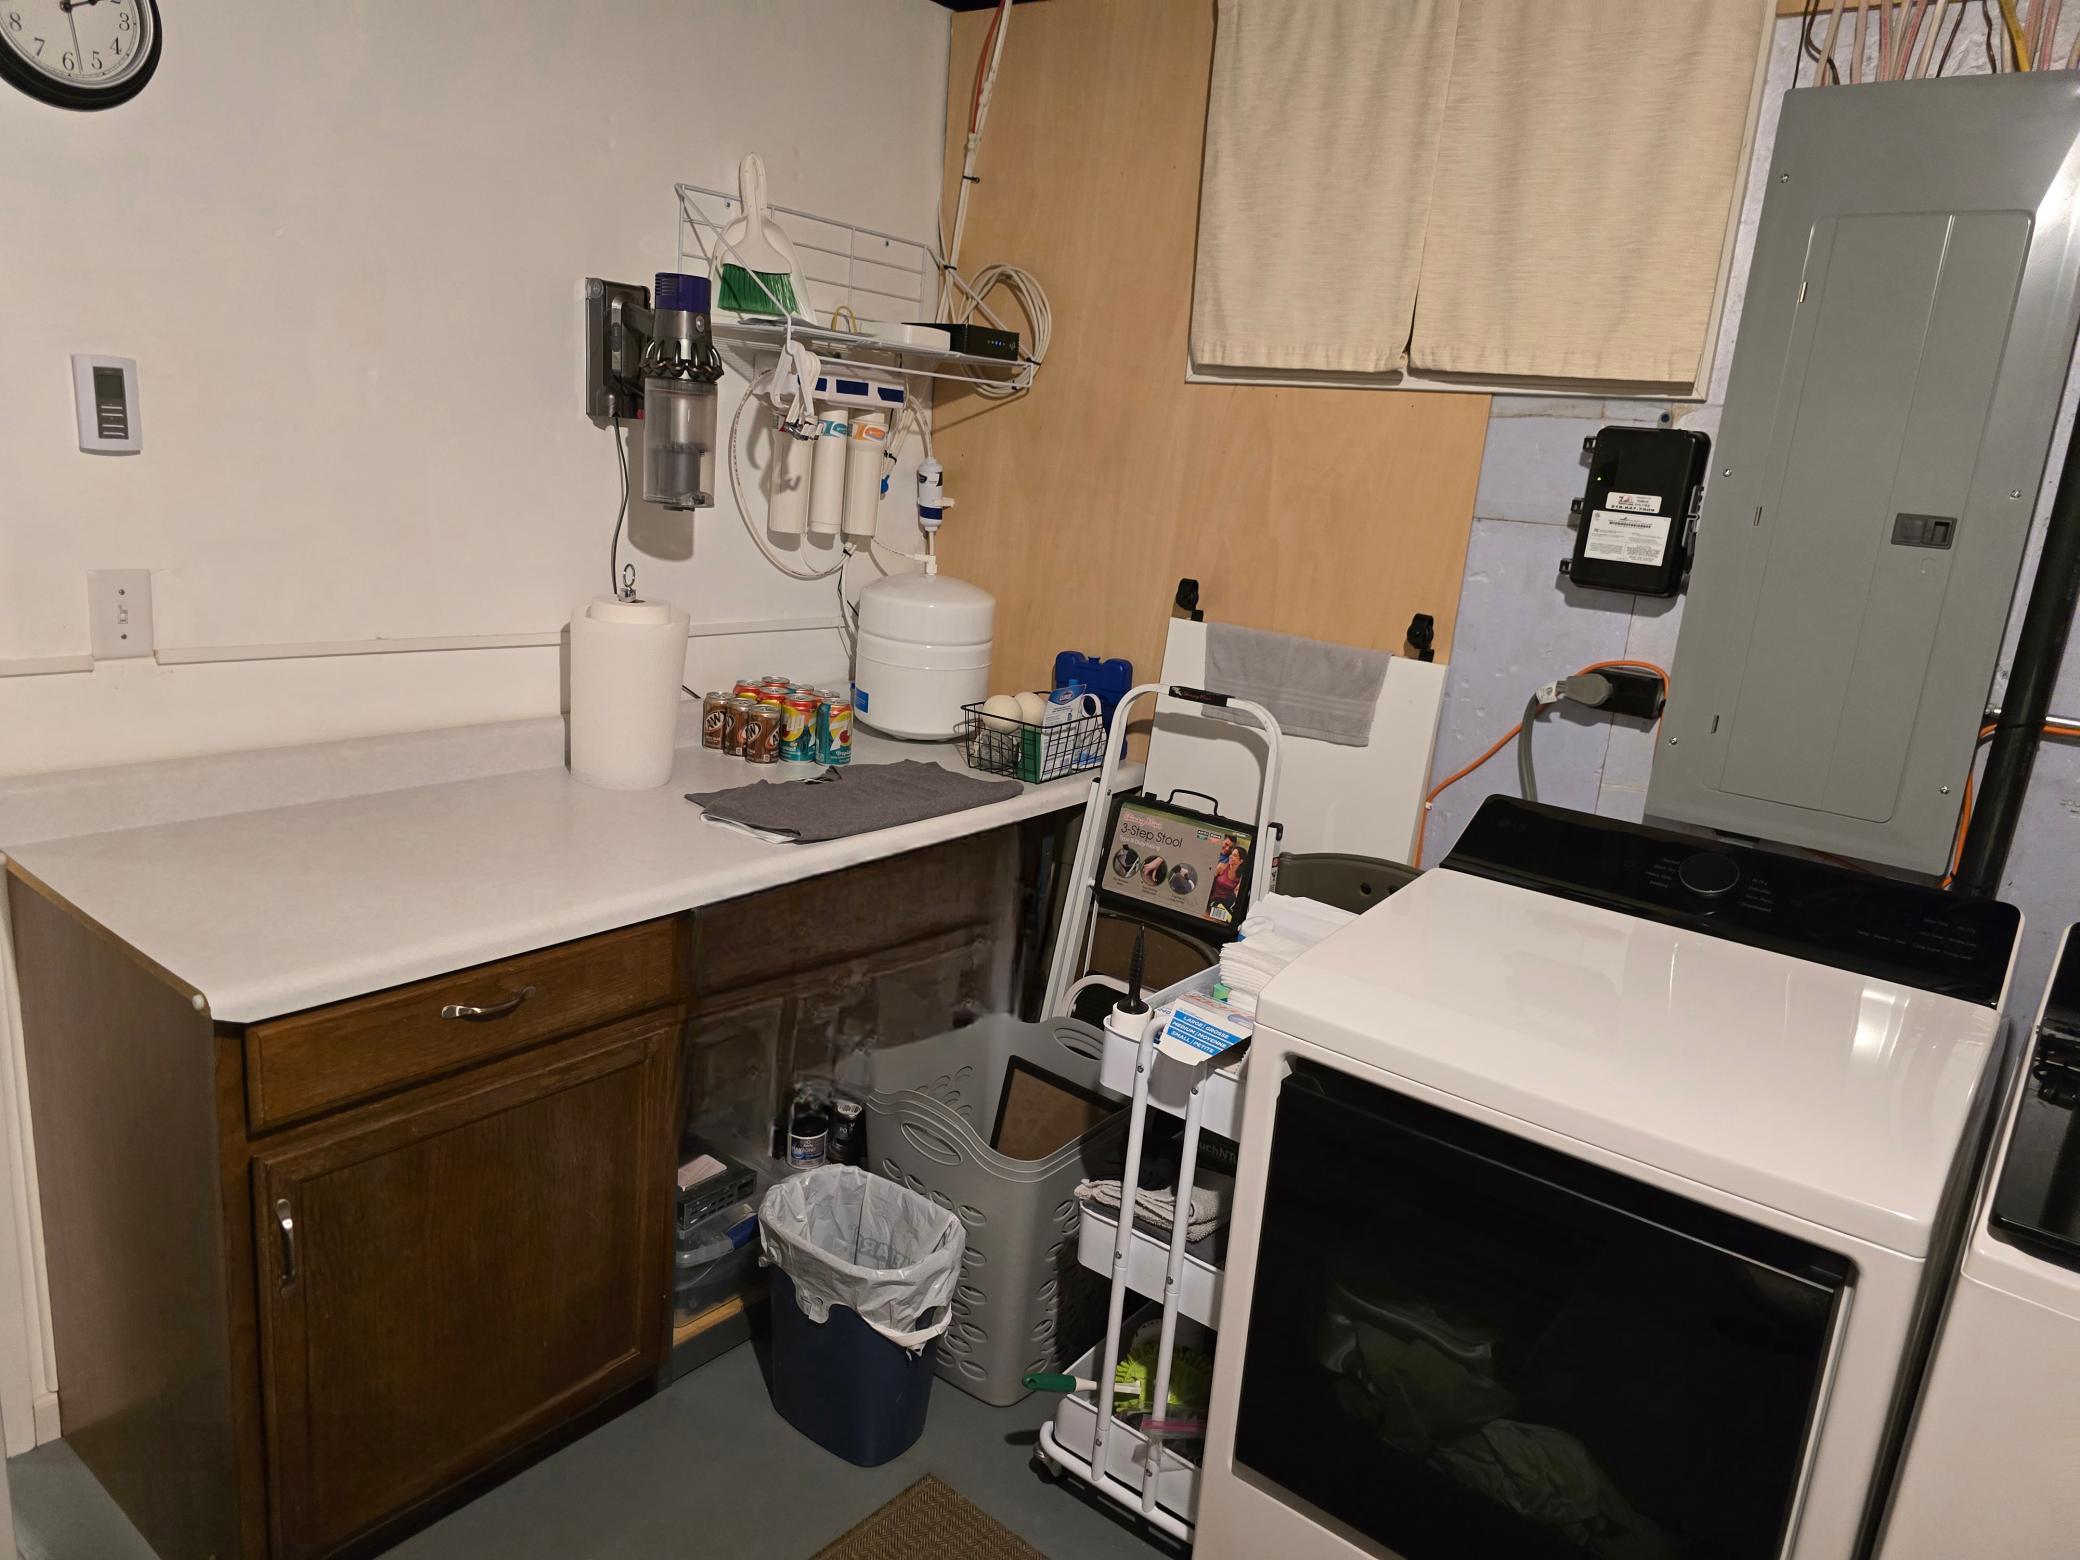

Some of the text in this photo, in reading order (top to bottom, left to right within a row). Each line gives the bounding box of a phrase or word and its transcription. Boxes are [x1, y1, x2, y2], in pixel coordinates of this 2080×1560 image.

[9, 12, 22, 31] 8
[119, 12, 130, 31] 3
[34, 37, 45, 56] 7
[110, 37, 122, 55] 4
[62, 52, 74, 71] 6
[91, 51, 103, 70] 5
[1121, 823, 1183, 848] 3-Step Stool
[1172, 1020, 1226, 1048] MEDIUM MOYENNE
[1182, 1016, 1230, 1039] LARGE GROSSE
[1171, 1030, 1215, 1054] SMALL PETITE
